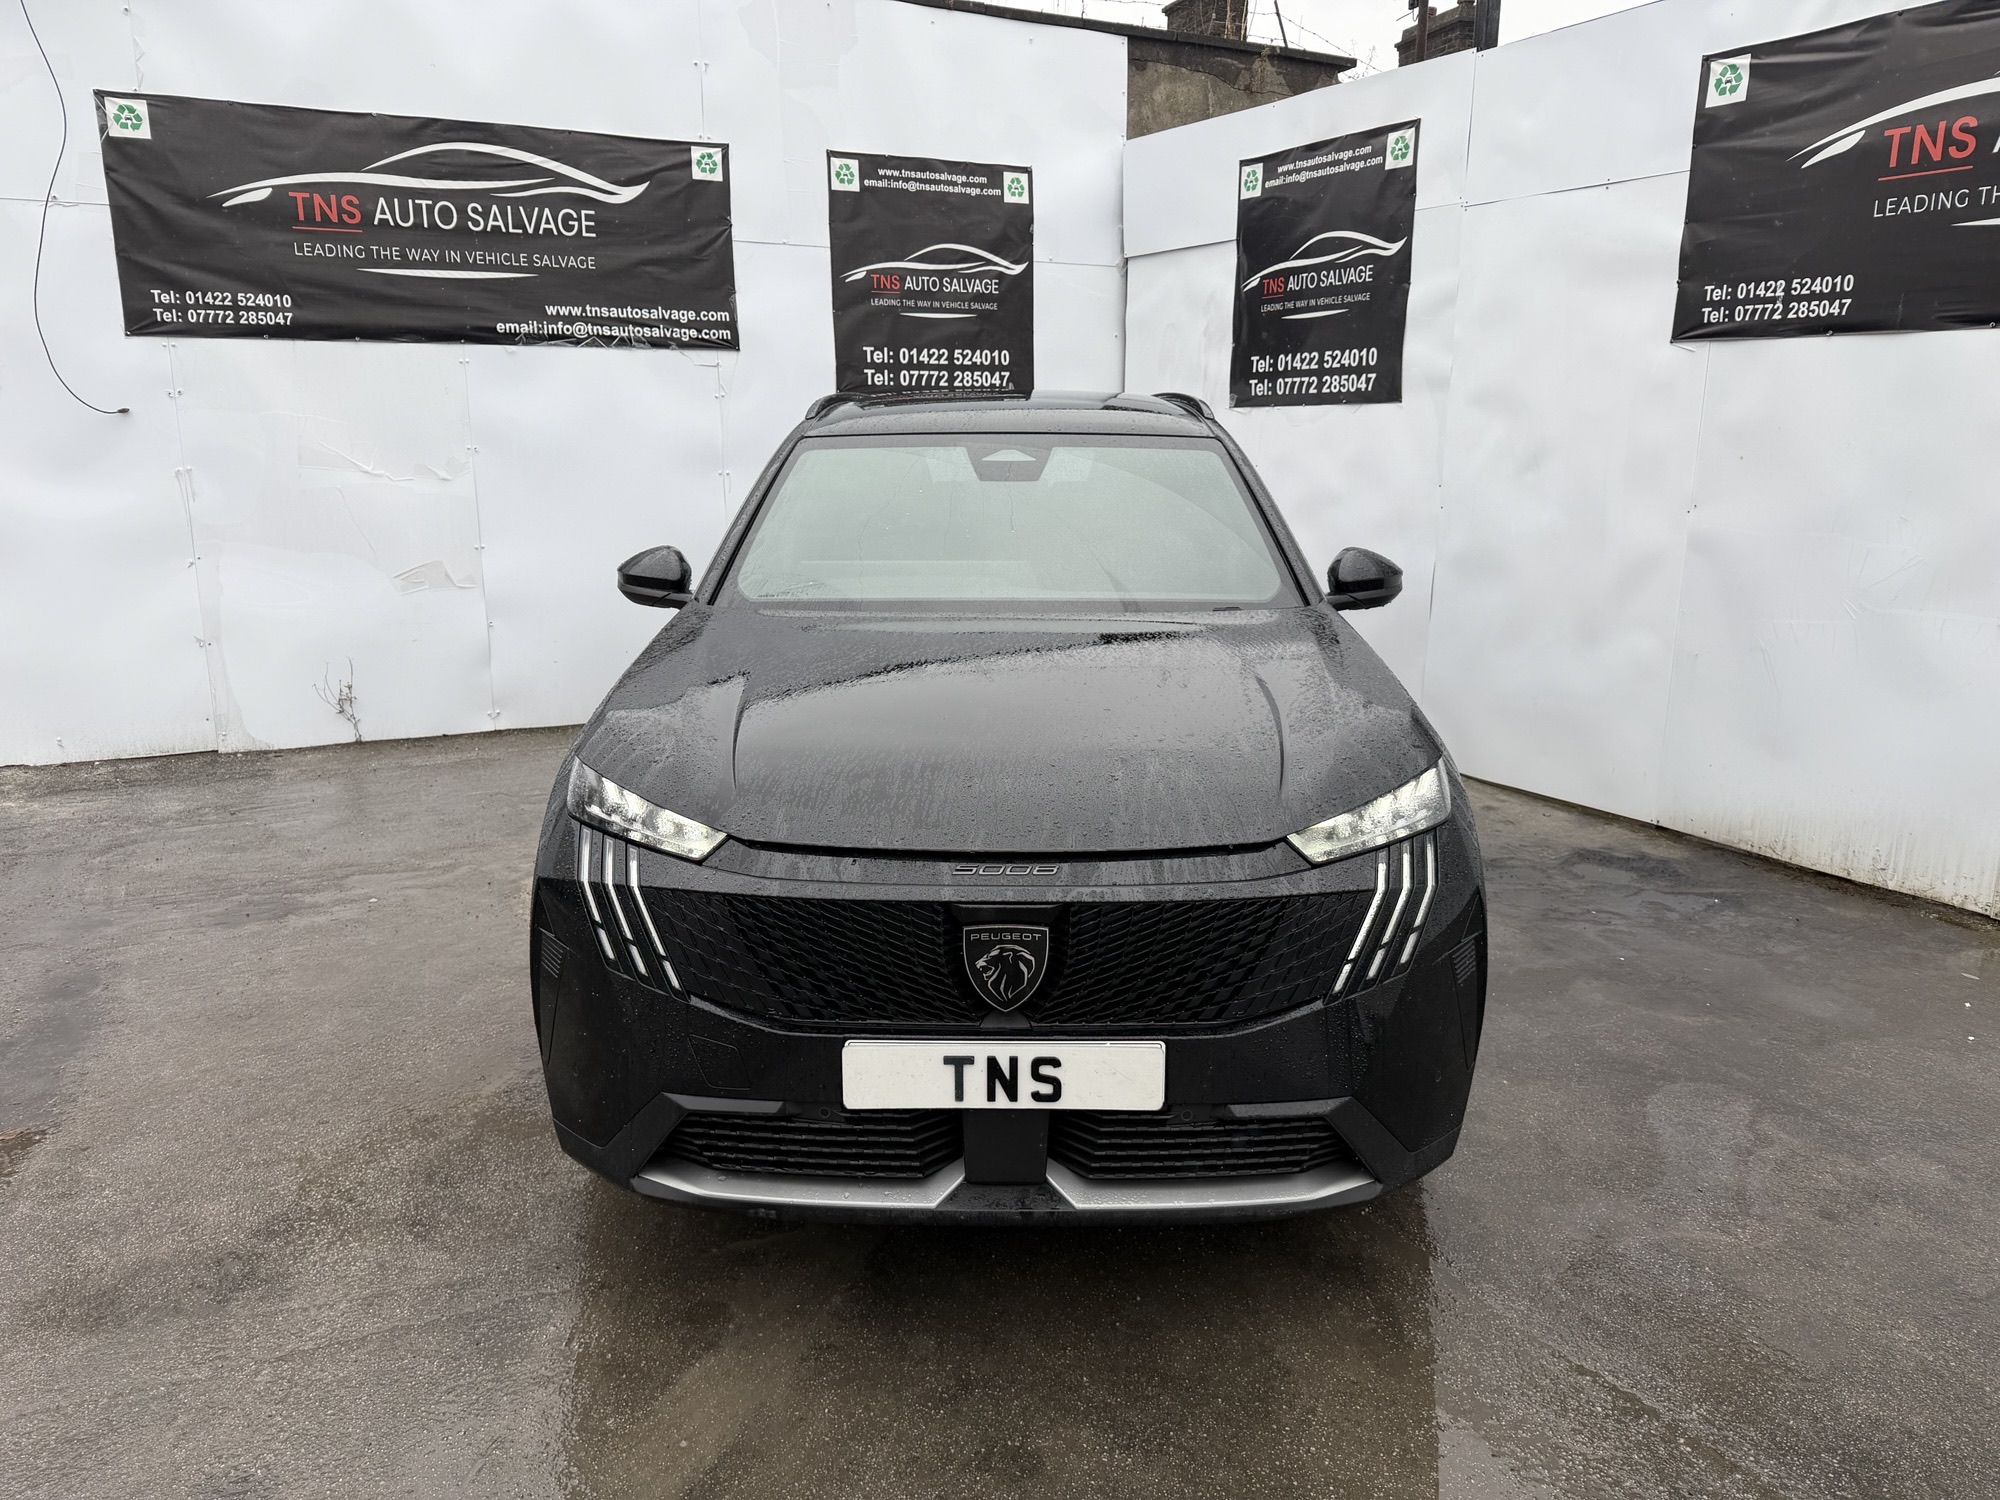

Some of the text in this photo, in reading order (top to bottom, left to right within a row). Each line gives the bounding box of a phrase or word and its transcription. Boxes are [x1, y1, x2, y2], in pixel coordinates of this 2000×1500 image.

[1884, 115, 1979, 168] TNS
[1277, 144, 1372, 174] www.tnsautosalvage.com
[877, 168, 988, 184] www.tnsautosalvage.com
[1264, 155, 1384, 188] email:info@tnsautosalvage.com
[863, 178, 1001, 197] email:info@tnsautosalvage.com
[1873, 189, 1969, 217] LEADING
[288, 191, 597, 237] TNS AUTO SALVAGE
[293, 241, 596, 270] LEADING THE WAY IN VEHICLE SALVAGE
[870, 274, 999, 294] TNS AUTO SALVAGE
[1262, 264, 1374, 295] TNS AUTO SALVAGE
[1703, 274, 1855, 302] Tel: 01422 524010
[150, 289, 292, 308] Tel: 01422 524010
[870, 298, 998, 311] LEADING THE WAY IN VEHICLE SALVAGE
[1260, 292, 1371, 313] LEADING THE WAY IN VEHICLE SALVAGE
[152, 308, 294, 326] Tel: 07772 285047
[545, 304, 730, 323] www.tnsautosalvage.com
[1701, 299, 1852, 324] Tel: 07772 285047
[496, 321, 732, 341] email:info@tnsautosalvage.com
[863, 346, 1010, 366] Tel: 01422 524010
[1250, 347, 1378, 373] Tel: 01422 524010
[864, 369, 1010, 388] Tel: 07772 285047
[1249, 373, 1377, 396] Tel: 07772 285047
[952, 863, 1060, 876] 5008
[970, 932, 1042, 941] PEUGEOT
[943, 1056, 1062, 1104] TNS
